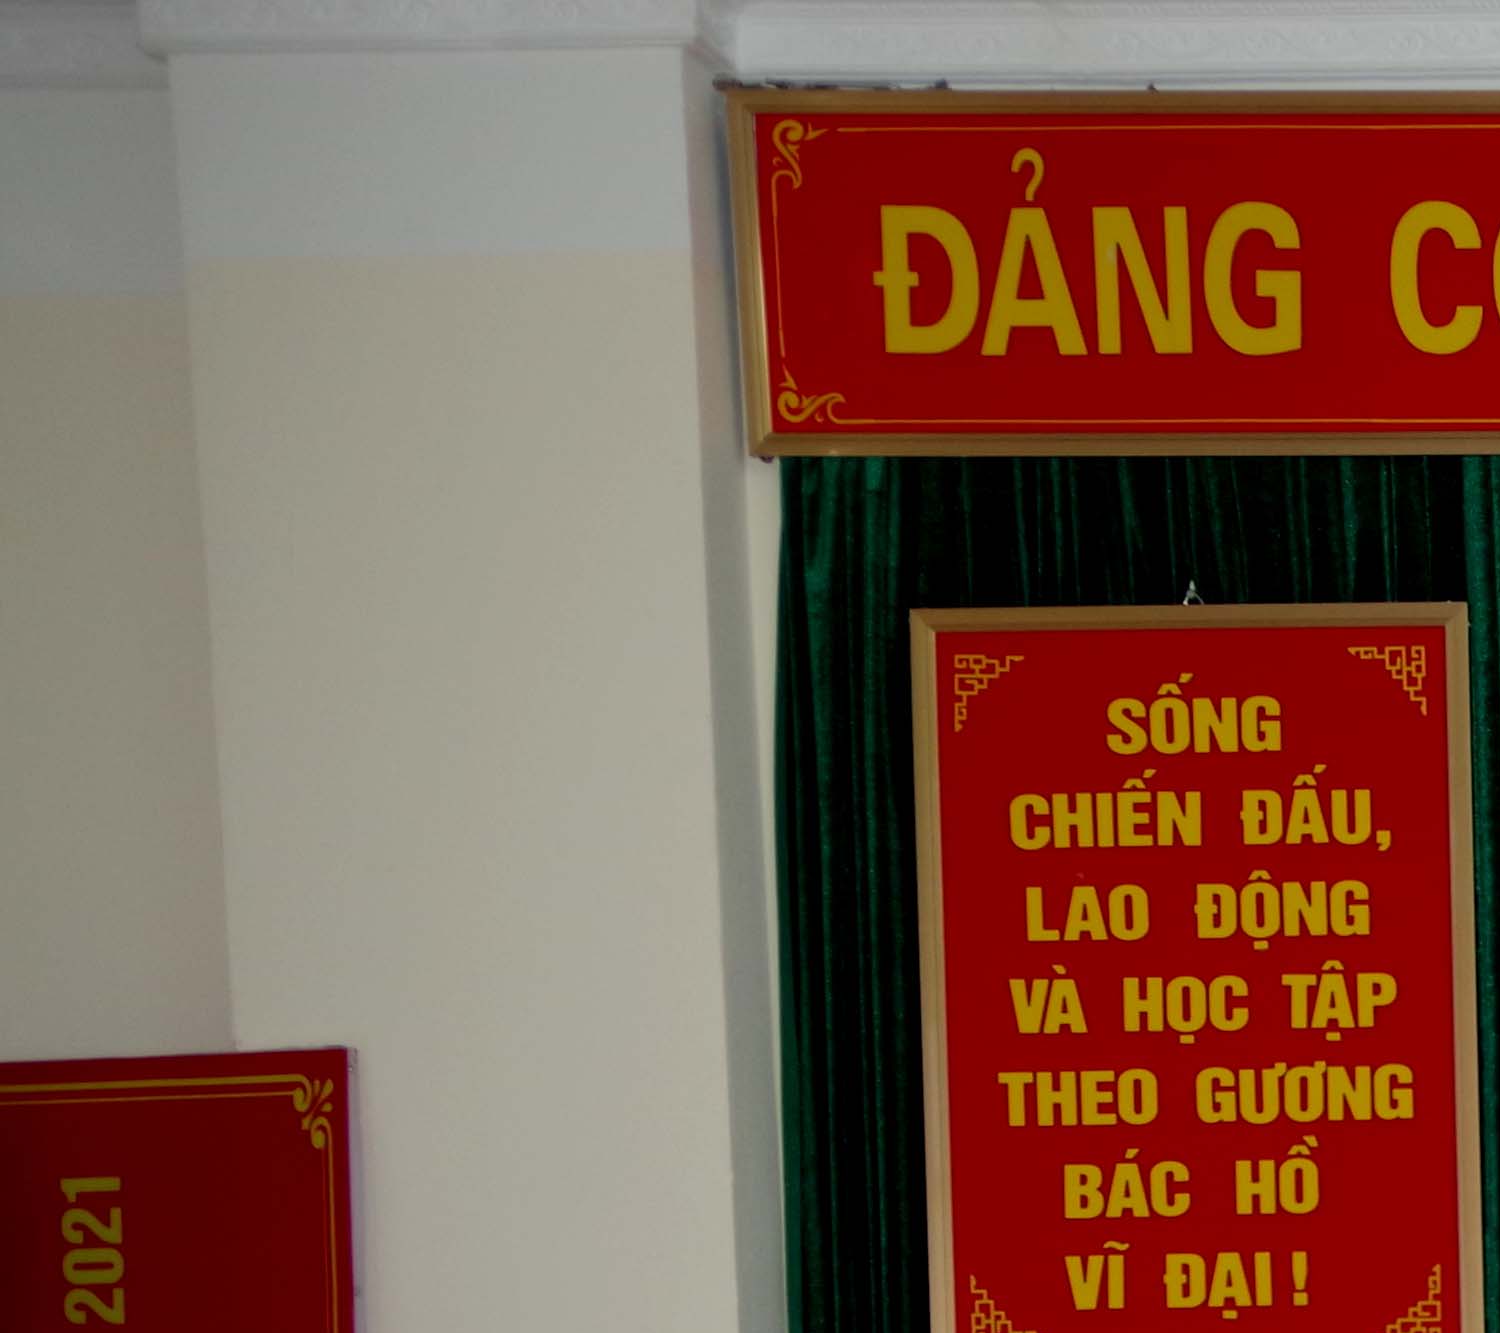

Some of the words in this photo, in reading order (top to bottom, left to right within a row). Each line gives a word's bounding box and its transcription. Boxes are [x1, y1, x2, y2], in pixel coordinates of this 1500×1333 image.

[874, 149, 1300, 355] ĐẢNG
[1106, 673, 1282, 754] SỐNG
[1009, 769, 1201, 850] CHIẾN
[1240, 764, 1391, 851] ĐẤU,
[1026, 886, 1149, 941] LAO
[1194, 870, 1371, 950] ĐỘNG
[1009, 964, 1087, 1034] VÀ
[1122, 974, 1249, 1044] HỌC
[1282, 960, 1397, 1041] TẬP
[999, 1068, 1157, 1126] THEO
[1196, 1060, 1414, 1123] GƯƠNG
[1063, 1148, 1190, 1219] BÁC
[1235, 1135, 1321, 1215] HỒ
[60, 1173, 125, 1324] 2021
[1064, 1240, 1129, 1310] VĨ
[1163, 1251, 1271, 1320] ĐẠI
